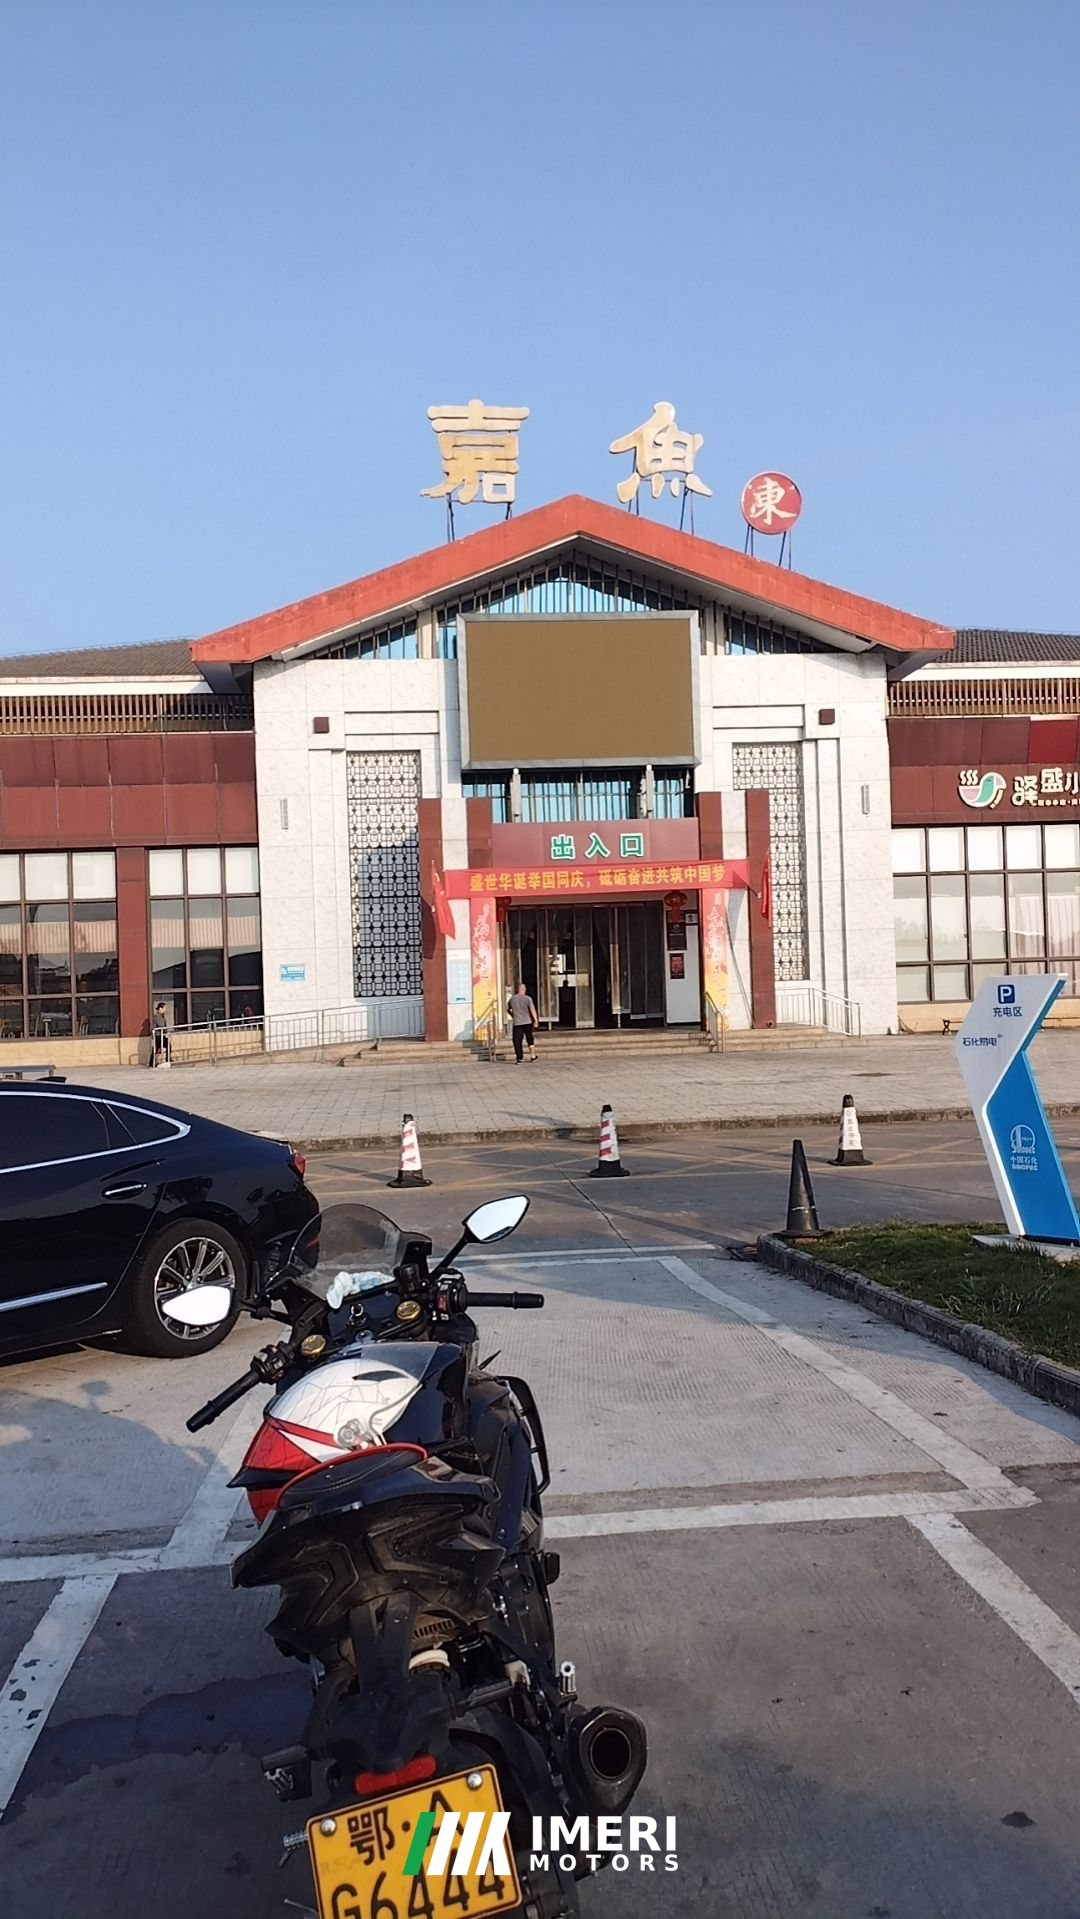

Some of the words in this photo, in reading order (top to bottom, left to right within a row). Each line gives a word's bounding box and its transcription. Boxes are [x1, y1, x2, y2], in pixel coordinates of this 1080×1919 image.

[551, 832, 644, 860] 出入口
[1000, 986, 1012, 1003] P
[993, 1006, 1023, 1017] 充电区
